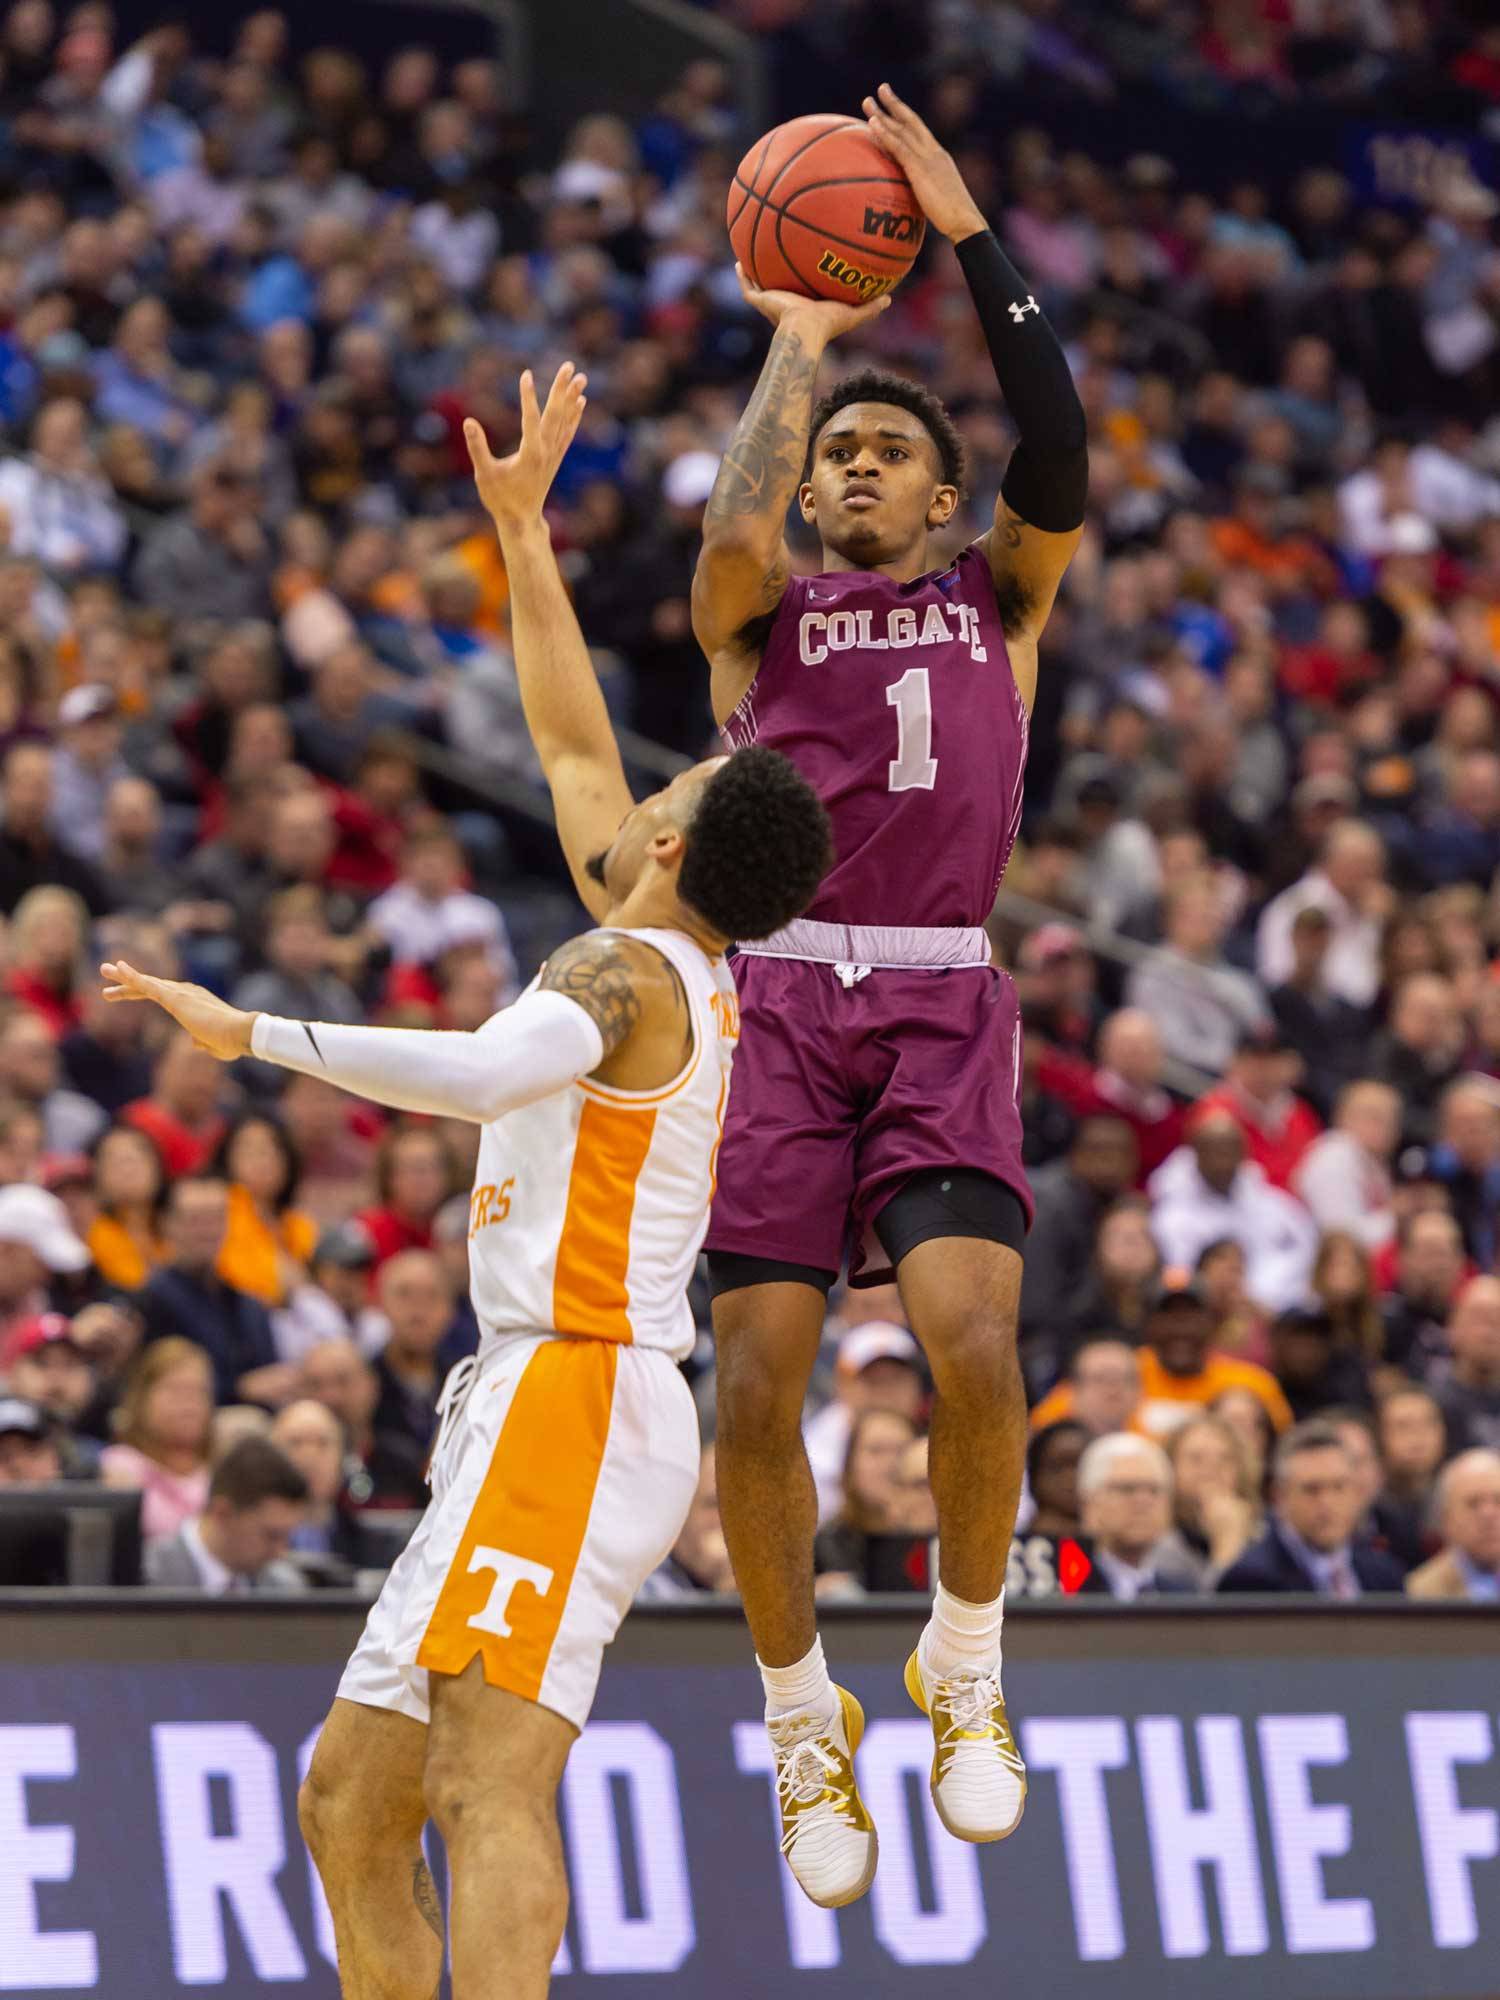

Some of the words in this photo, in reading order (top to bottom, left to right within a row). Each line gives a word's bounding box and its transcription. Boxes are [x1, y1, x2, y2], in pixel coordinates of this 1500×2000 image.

[885, 667, 938, 792] 1
[466, 1544, 554, 1638] T
[1022, 1713, 1377, 1960] THE
